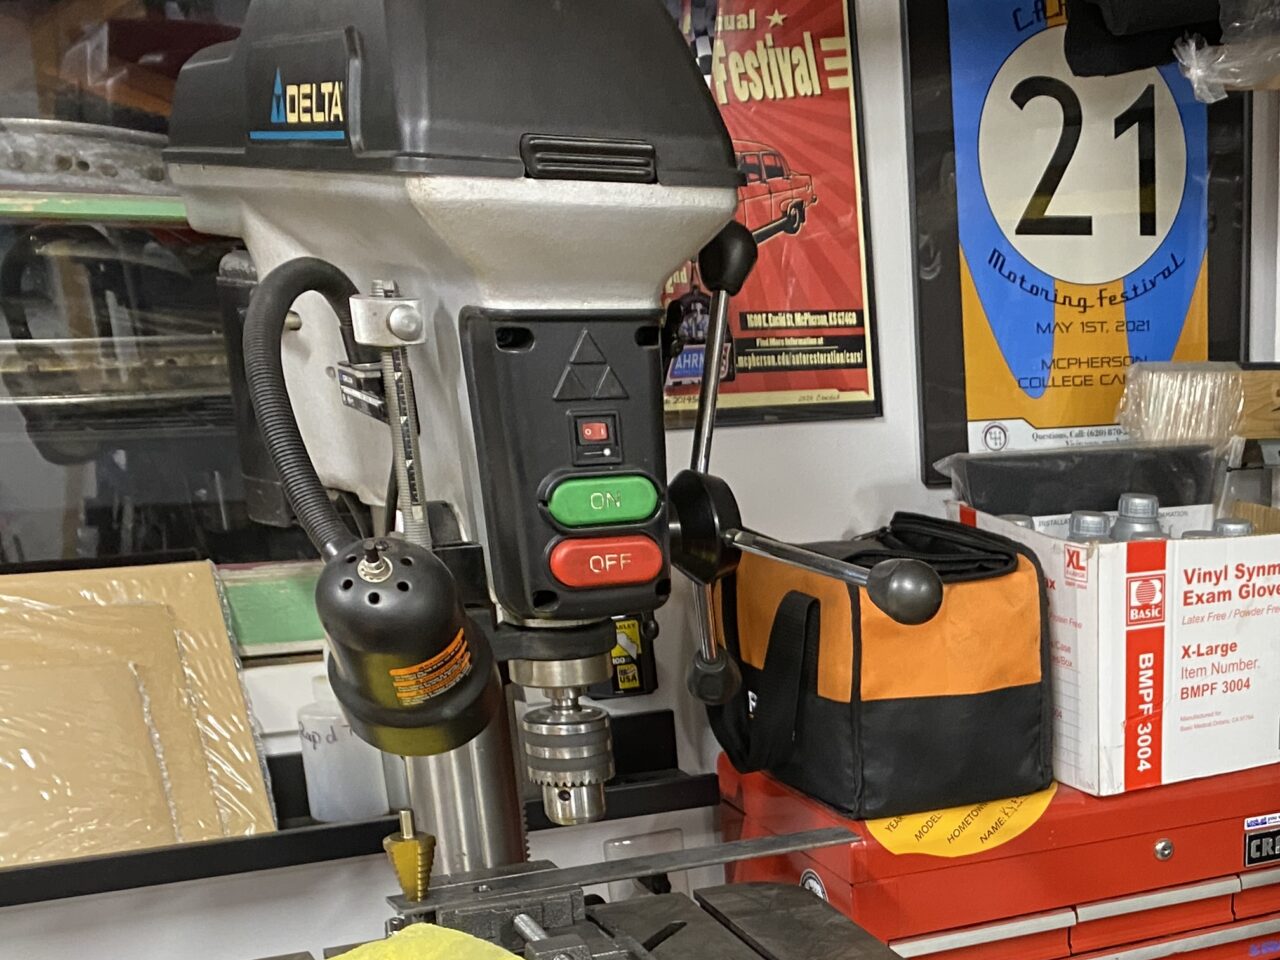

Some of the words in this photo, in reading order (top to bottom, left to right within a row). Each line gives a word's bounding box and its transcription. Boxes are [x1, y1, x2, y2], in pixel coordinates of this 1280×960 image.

[714, 31, 822, 104] Festival
[286, 81, 343, 123] DELTA
[1010, 75, 1156, 236] 21
[988, 248, 1095, 313] Motoring
[1036, 321, 1073, 334] MAY
[1081, 320, 1110, 334] 1ST,
[1115, 319, 1150, 332] 2021
[1041, 355, 1148, 371] MCPHERSON
[1018, 375, 1093, 389] COLLEGE
[1100, 373, 1126, 386] CA
[590, 492, 621, 509] ON
[589, 553, 632, 573] OFF
[1066, 548, 1086, 571] XL
[1184, 564, 1228, 586] Vinyl
[1183, 589, 1232, 607] Exam
[1182, 612, 1205, 626] Latex
[1207, 610, 1227, 622] Free
[1233, 606, 1264, 618] Powder
[1181, 641, 1238, 660] X-Large
[620, 674, 638, 683] USA
[1181, 665, 1207, 680] Item
[1138, 653, 1154, 715] BMPF
[1180, 682, 1218, 701] BMPF
[1222, 677, 1251, 695] 3004
[1137, 722, 1152, 772] 3004
[979, 815, 1007, 844] NAME:
